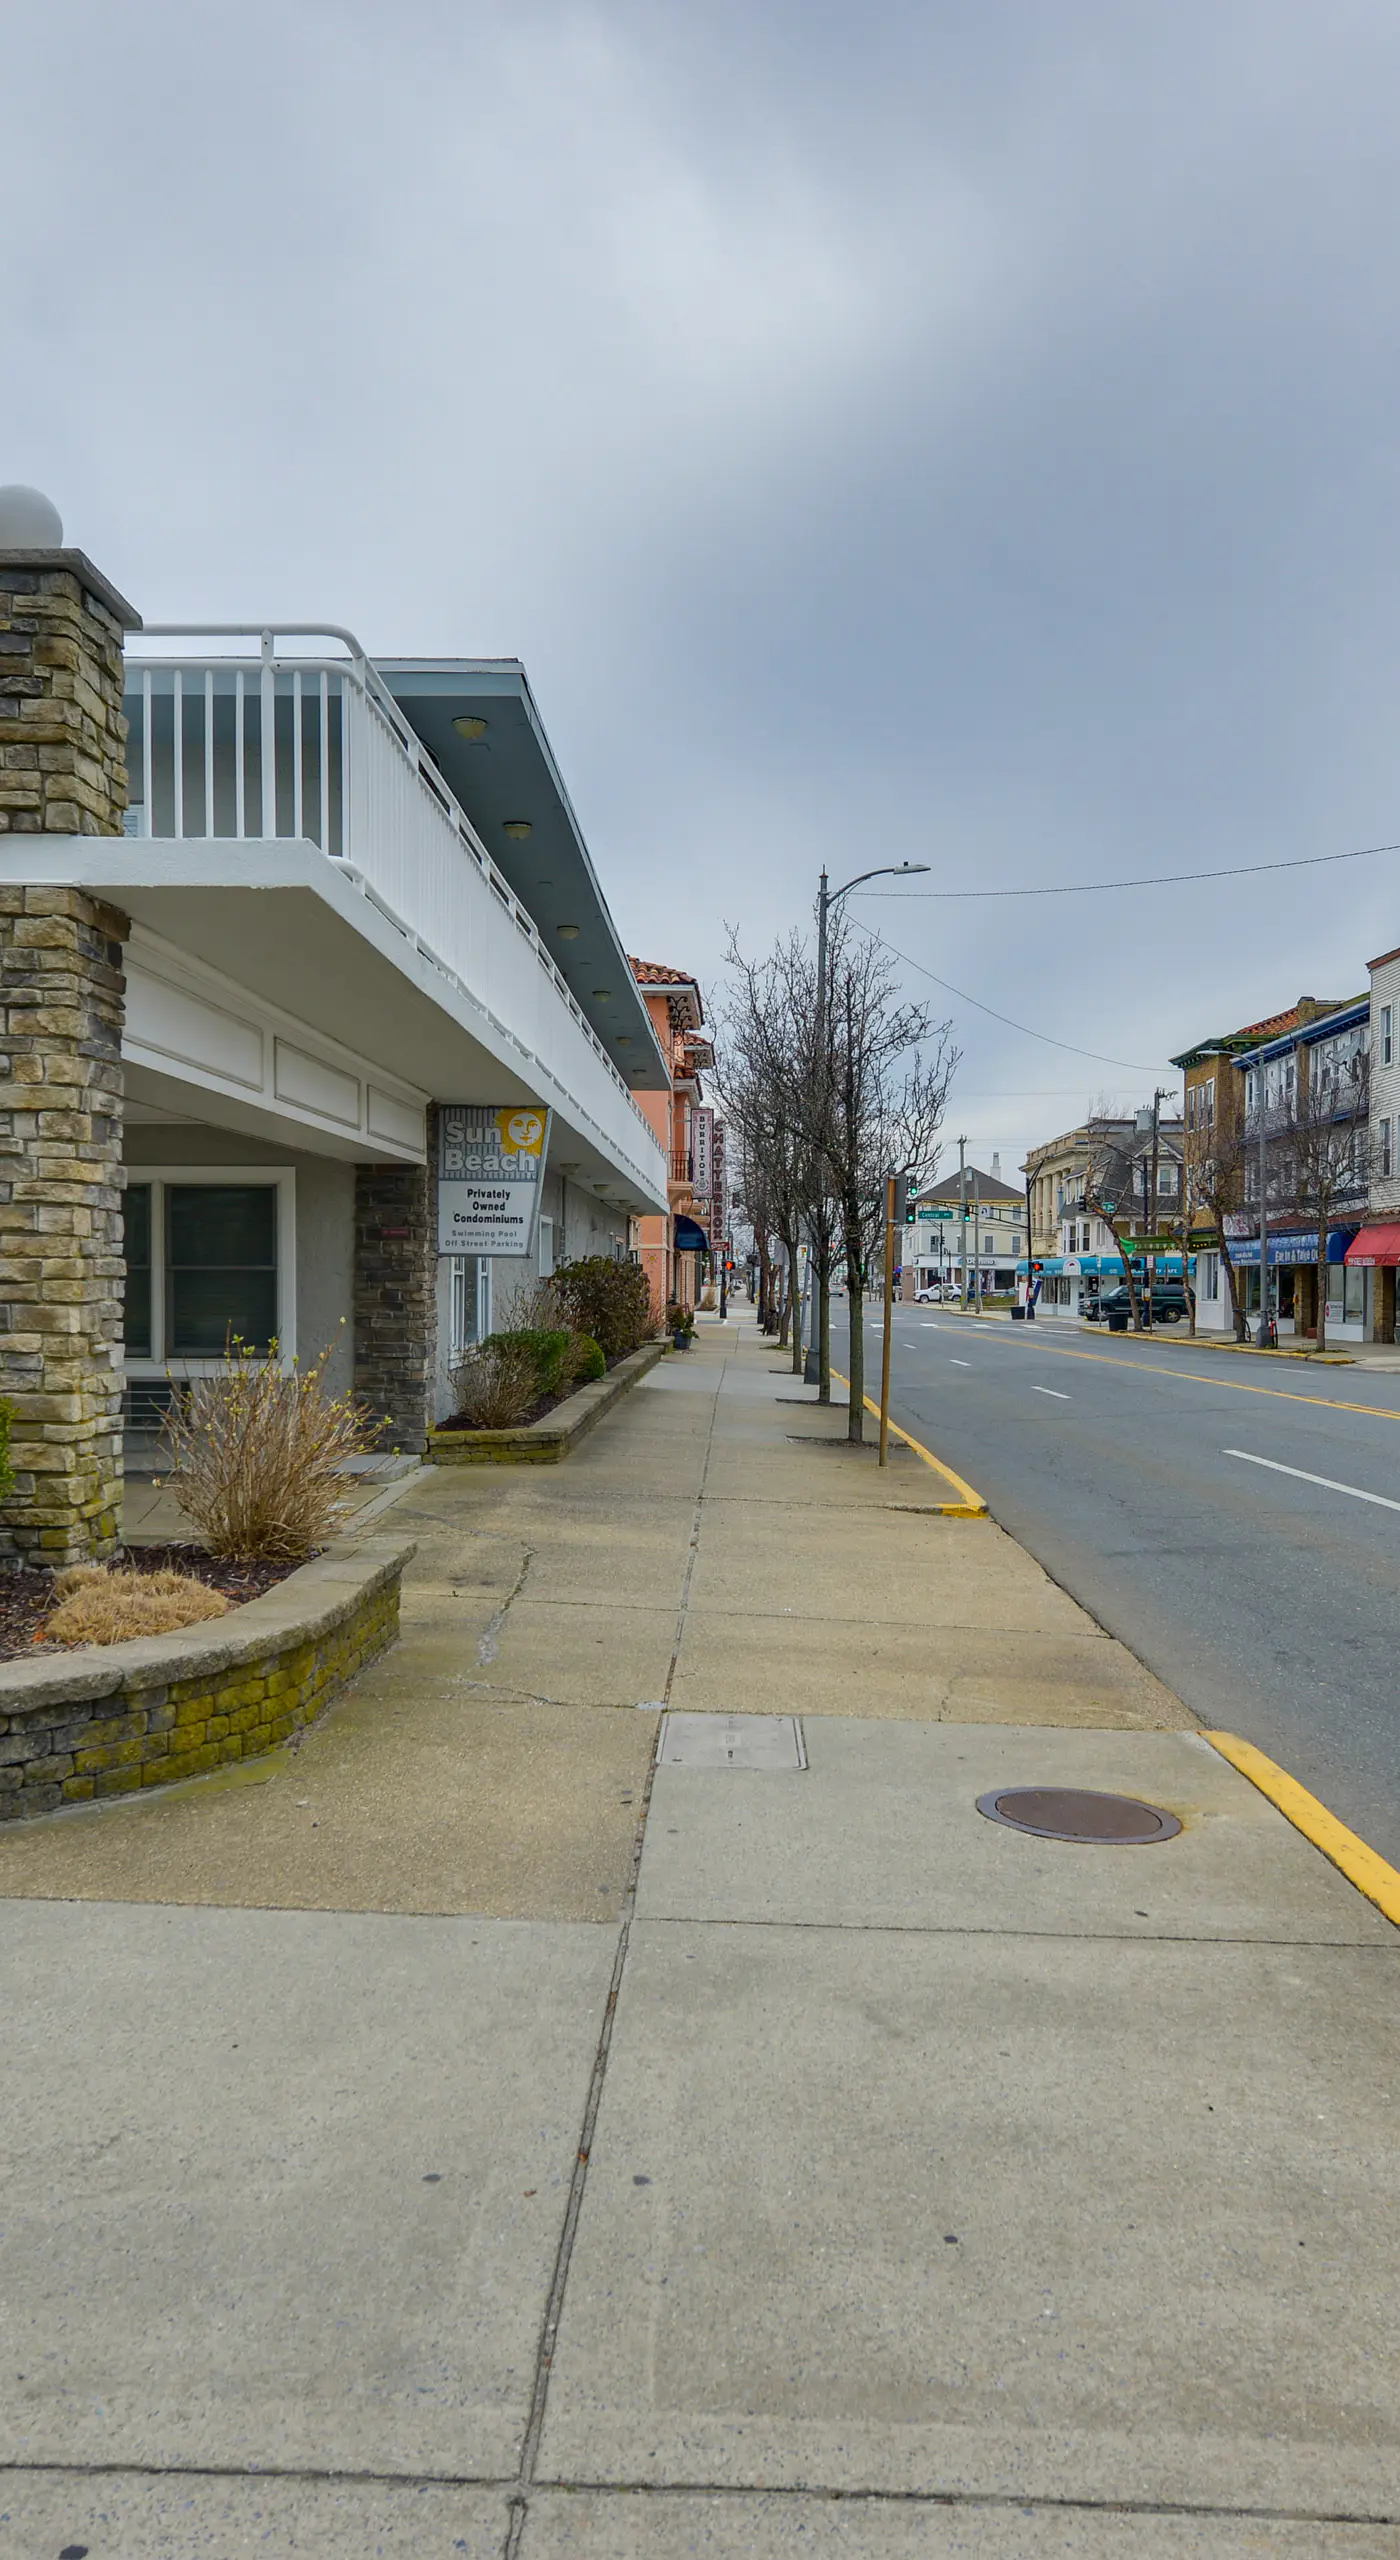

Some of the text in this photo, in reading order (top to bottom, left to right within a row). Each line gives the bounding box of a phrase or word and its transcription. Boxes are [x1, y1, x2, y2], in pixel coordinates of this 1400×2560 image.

[445, 1121, 503, 1144] Sun
[444, 1148, 536, 1172] Beach
[713, 1120, 724, 1240] CHATTERBOX
[467, 1189, 511, 1200] Privately
[472, 1202, 506, 1211] Owned
[453, 1213, 524, 1224] Condominiums
[452, 1230, 495, 1238] Swimming
[1311, 1248, 1319, 1261] Ou
